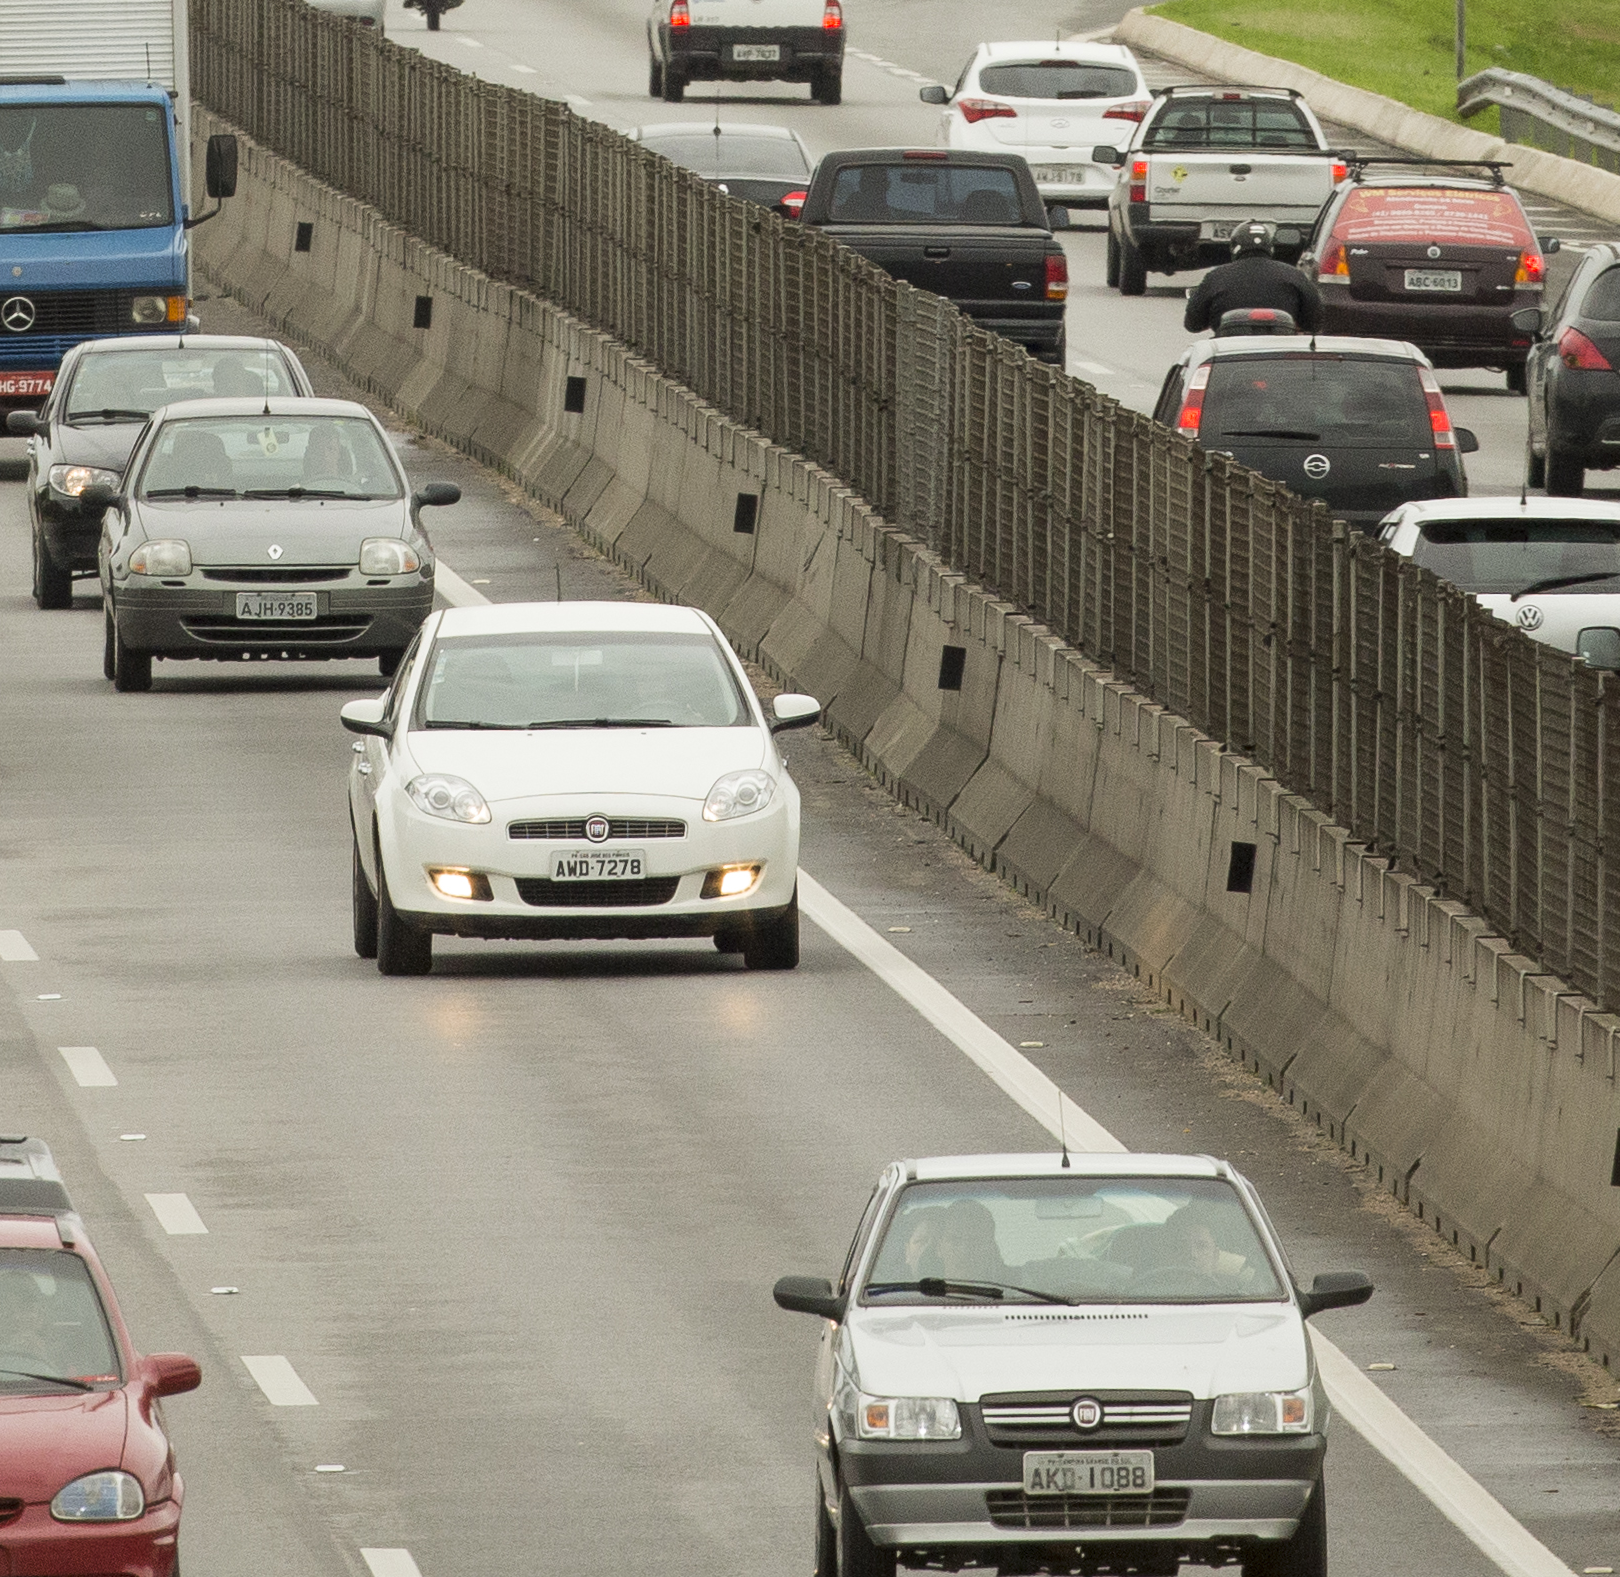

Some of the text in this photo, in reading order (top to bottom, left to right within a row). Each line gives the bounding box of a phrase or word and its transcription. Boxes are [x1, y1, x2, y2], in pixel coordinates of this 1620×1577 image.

[1387, 189, 1443, 198] Serviços
[240, 602, 314, 617] AJH-9385
[555, 859, 642, 878] AWD-7278
[1030, 1466, 1146, 1490] AKD-1088
